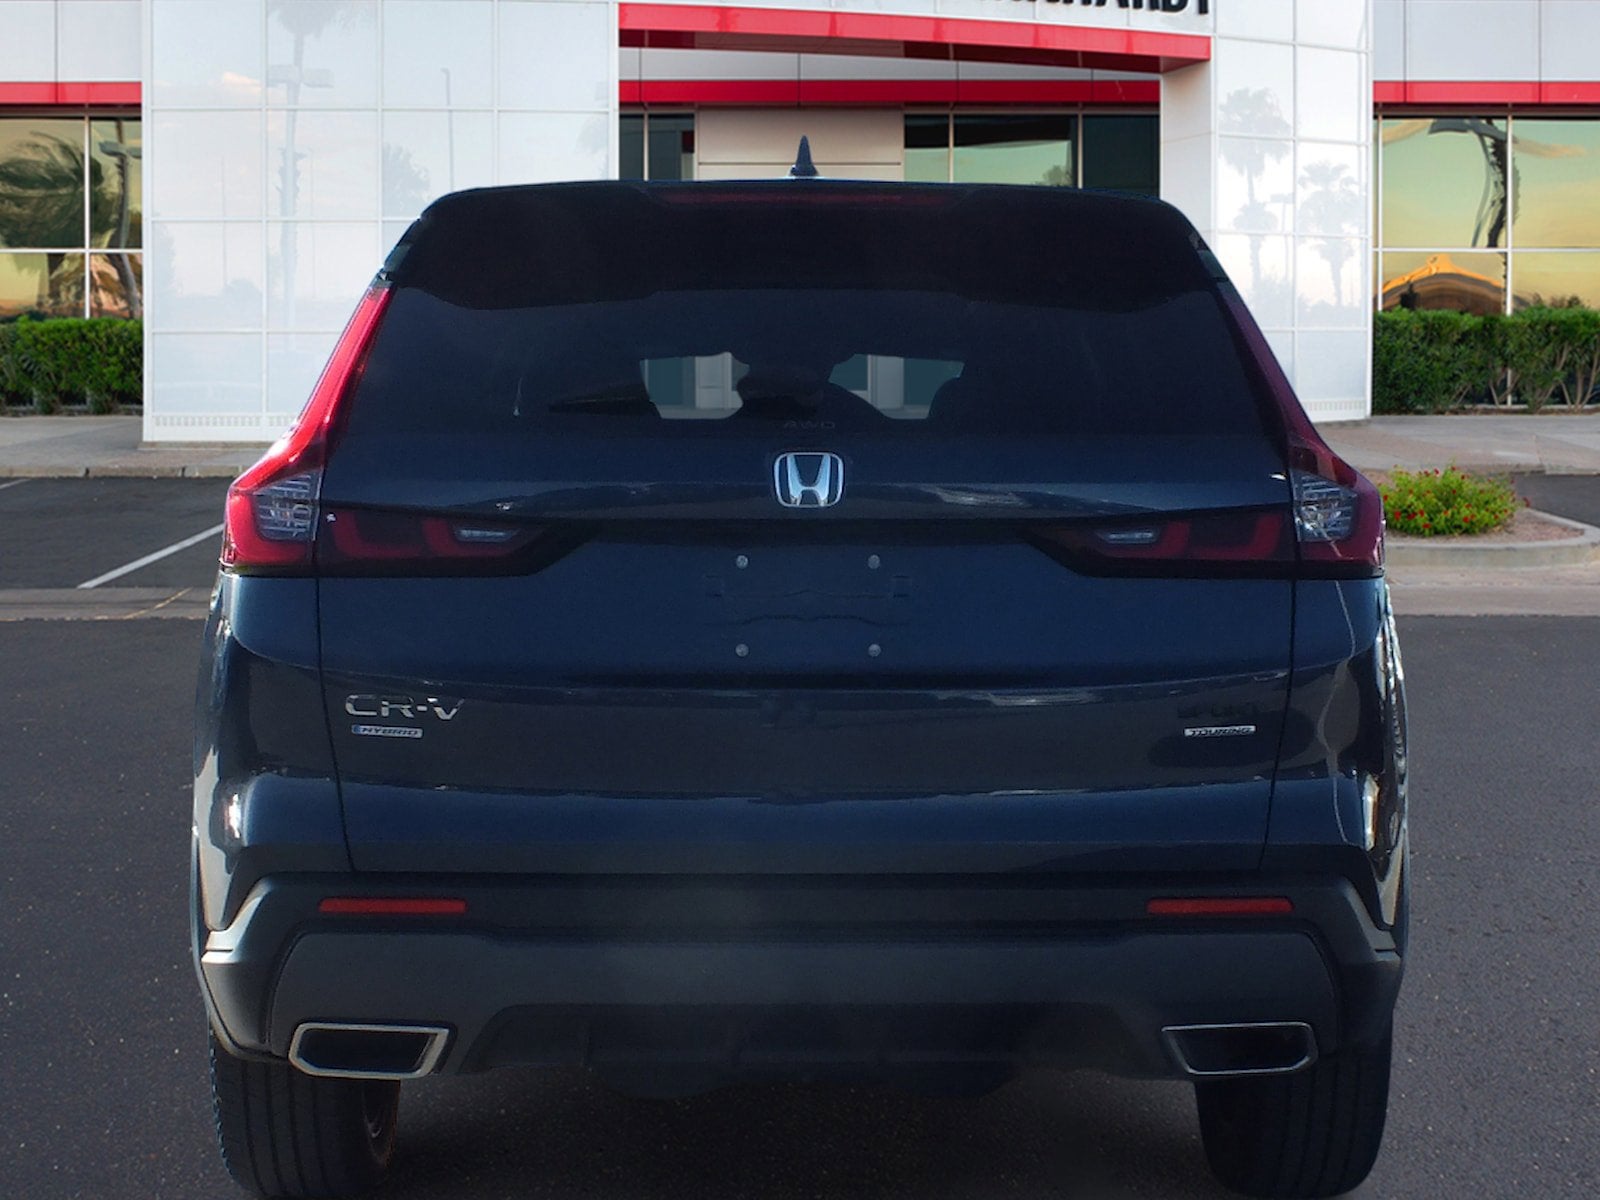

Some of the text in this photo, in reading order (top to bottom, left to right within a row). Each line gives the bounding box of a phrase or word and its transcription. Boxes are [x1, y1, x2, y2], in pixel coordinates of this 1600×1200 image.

[783, 420, 836, 429] AWD
[345, 694, 465, 720] CR-V
[1189, 726, 1253, 736] TOURING
